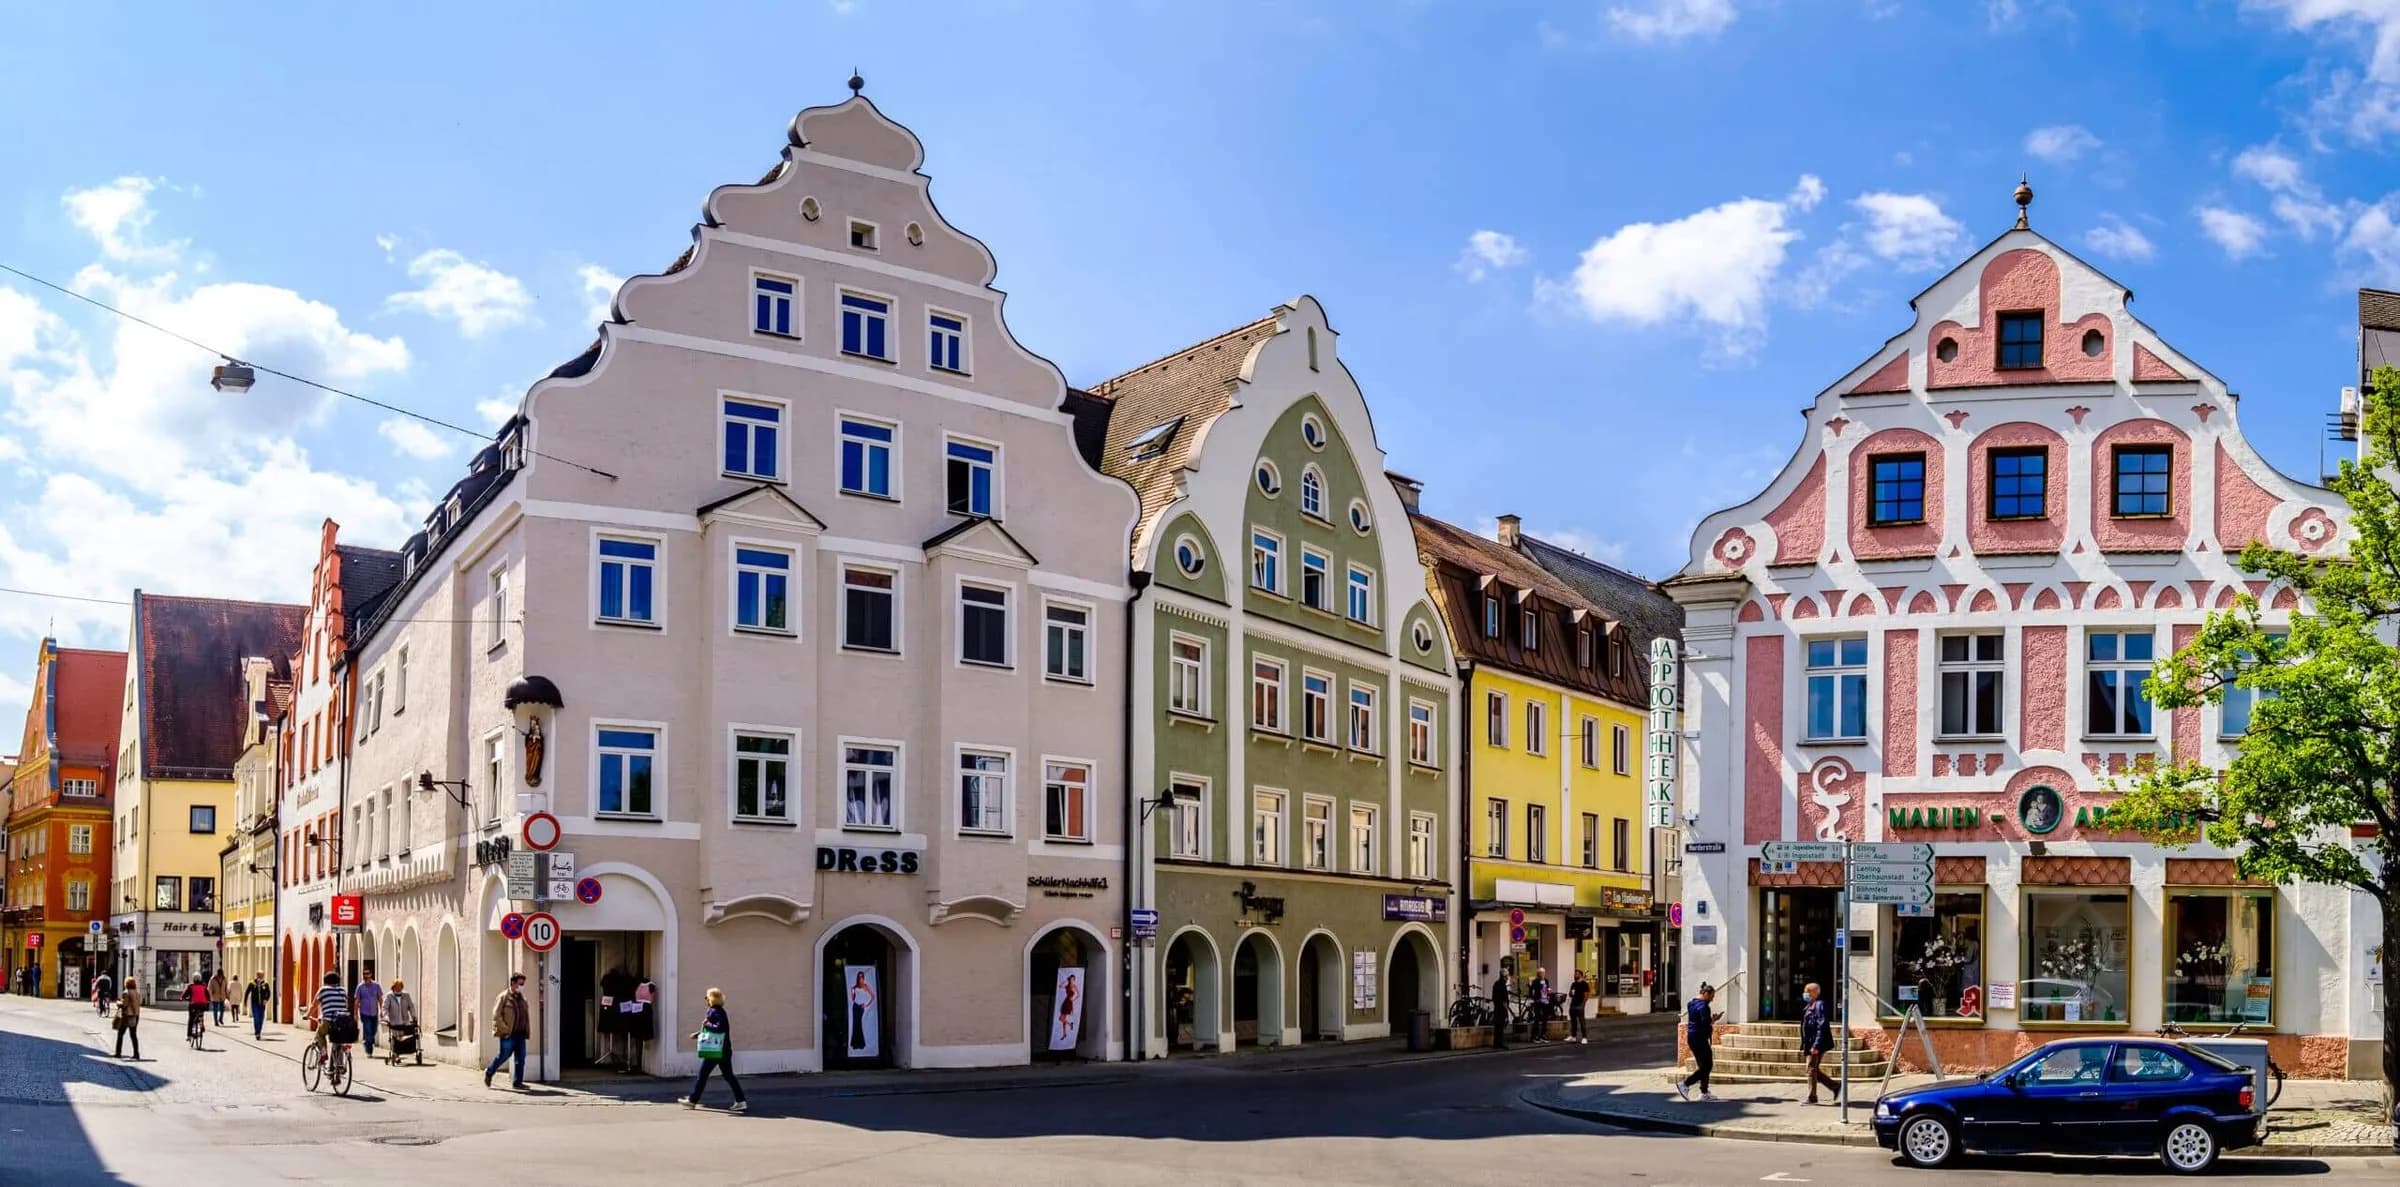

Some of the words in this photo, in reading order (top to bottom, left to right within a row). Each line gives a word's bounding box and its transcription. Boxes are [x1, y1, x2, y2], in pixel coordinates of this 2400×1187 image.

[1659, 640, 1674, 826] APOTHEKE
[1889, 807, 1980, 829] MARIEN
[817, 848, 918, 872] DReSS
[163, 922, 188, 932] Hair
[190, 923, 198, 932] &
[533, 924, 551, 941] 10
